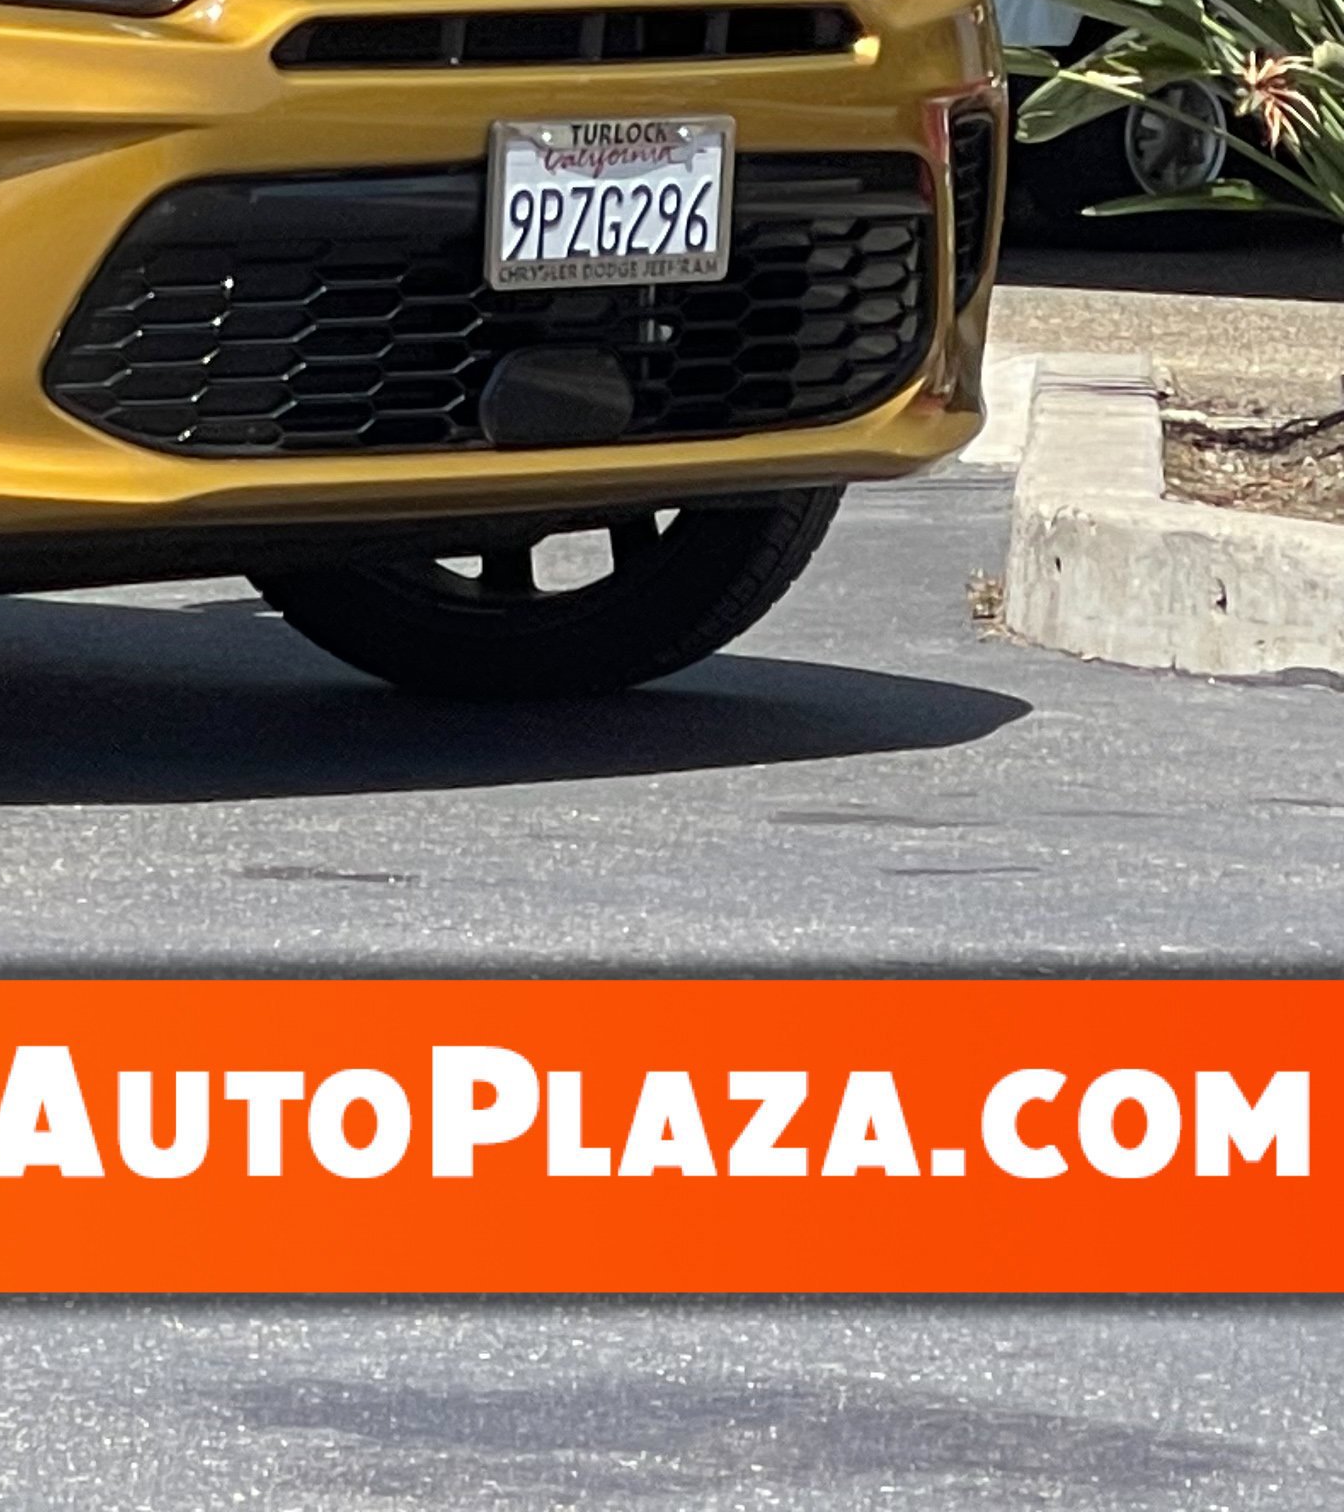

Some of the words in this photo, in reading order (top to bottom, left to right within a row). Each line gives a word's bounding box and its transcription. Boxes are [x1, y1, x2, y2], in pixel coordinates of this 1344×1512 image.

[570, 121, 669, 147] TURLOCK
[543, 143, 680, 179] California
[506, 180, 713, 262] 9PZG296
[582, 261, 638, 281] DODGE
